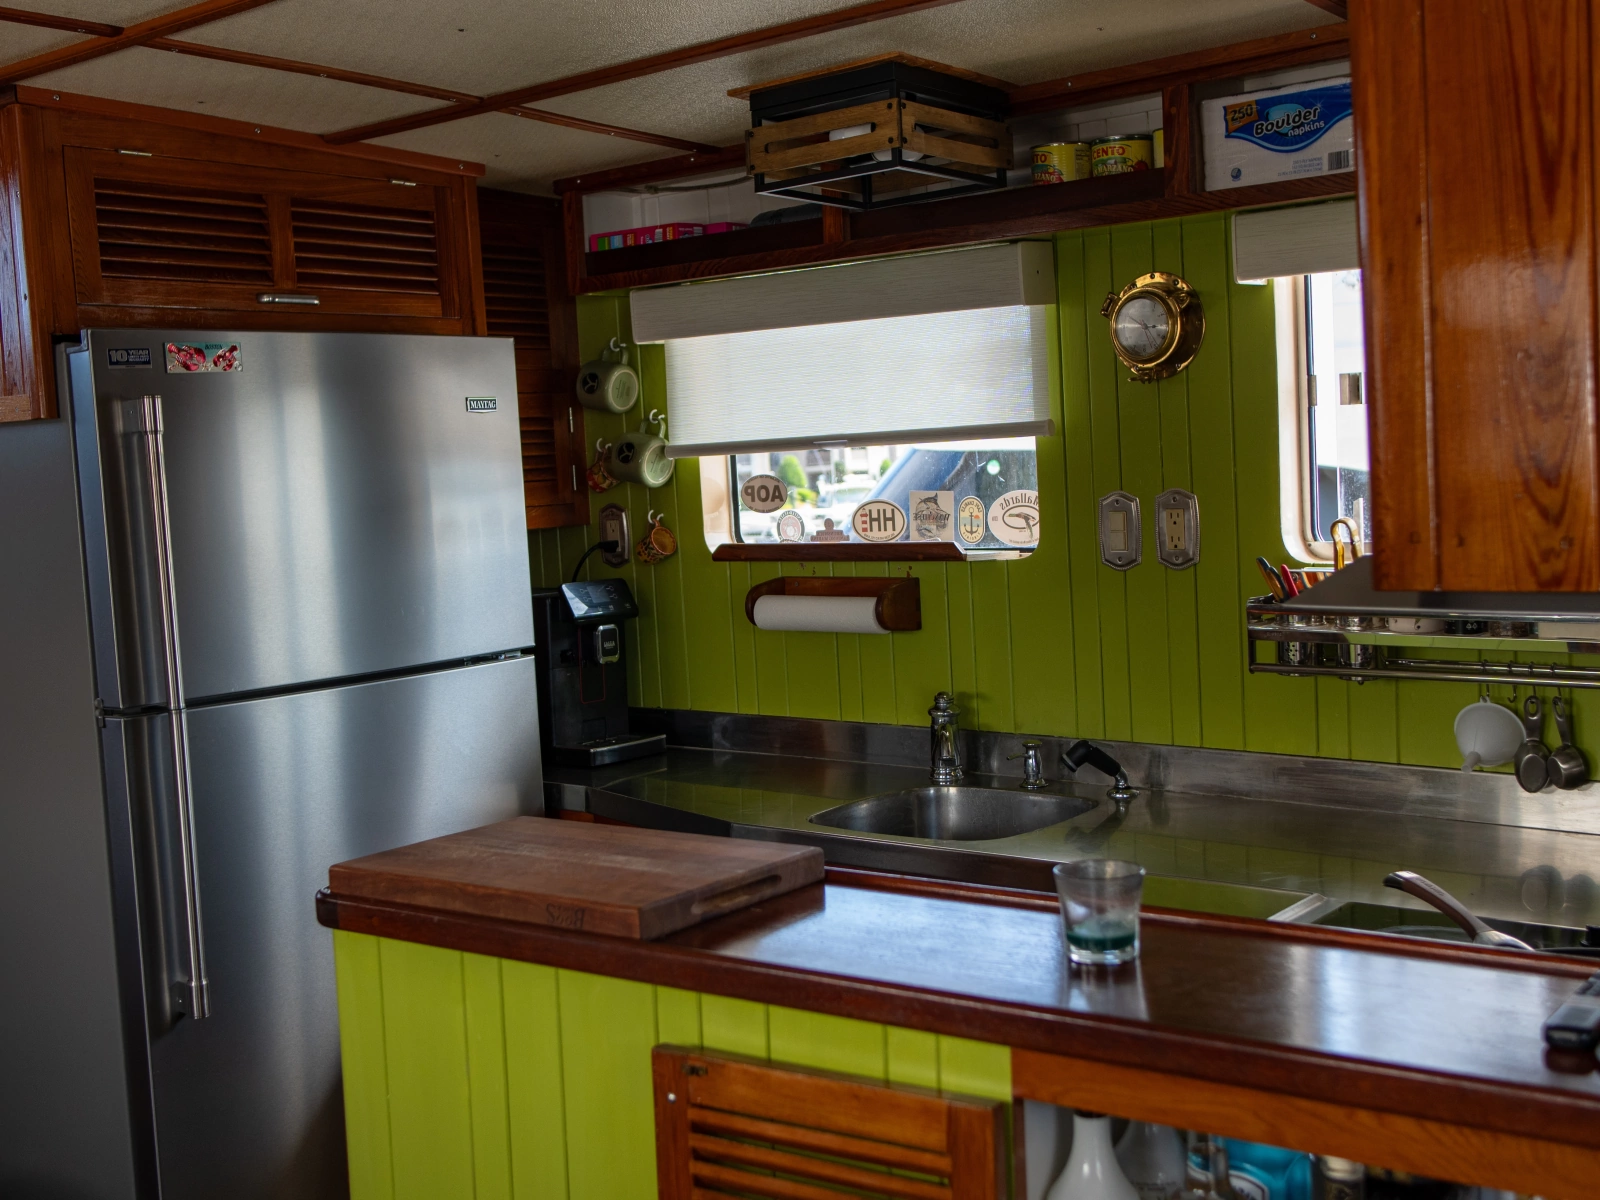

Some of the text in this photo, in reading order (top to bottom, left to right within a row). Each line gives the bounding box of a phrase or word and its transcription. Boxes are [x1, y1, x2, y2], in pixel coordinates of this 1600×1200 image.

[1230, 104, 1254, 122] 250
[1254, 106, 1321, 137] Boulder
[1288, 120, 1325, 138] napkins
[1092, 146, 1126, 160] CENTO
[109, 349, 127, 362] 10
[470, 400, 496, 409] MAYTAG
